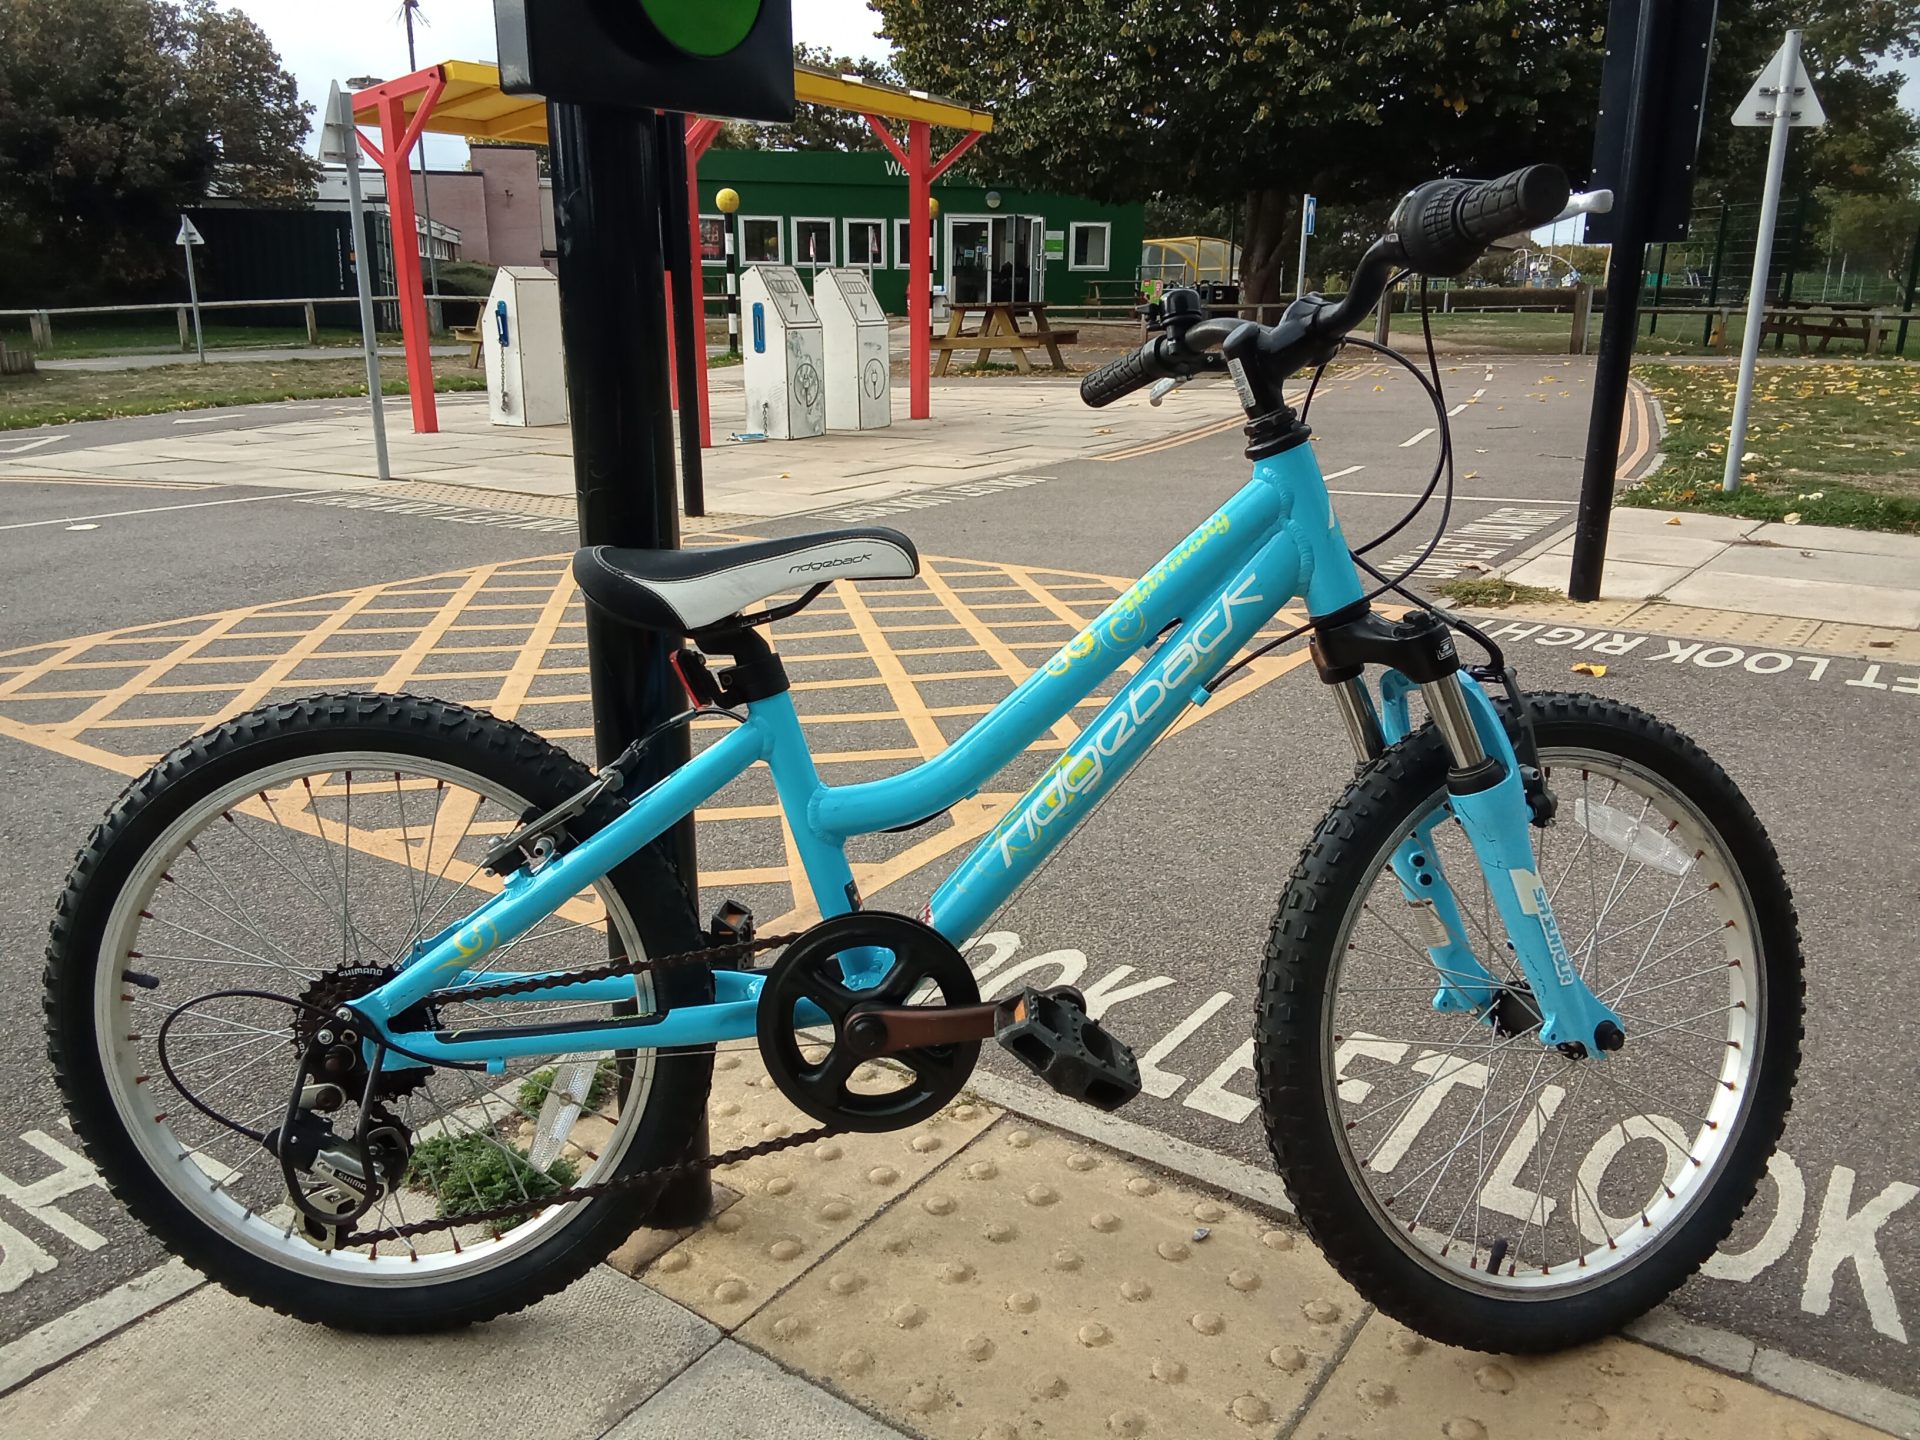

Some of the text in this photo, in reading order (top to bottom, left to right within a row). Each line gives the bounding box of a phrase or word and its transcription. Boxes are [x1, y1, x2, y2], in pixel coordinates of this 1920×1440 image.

[788, 553, 872, 574] ridgeback
[1643, 638, 1831, 682] LOOK
[1000, 573, 1263, 868] ridgeback
[338, 966, 383, 978] SHIMANO
[337, 1172, 380, 1196] SHIMA
